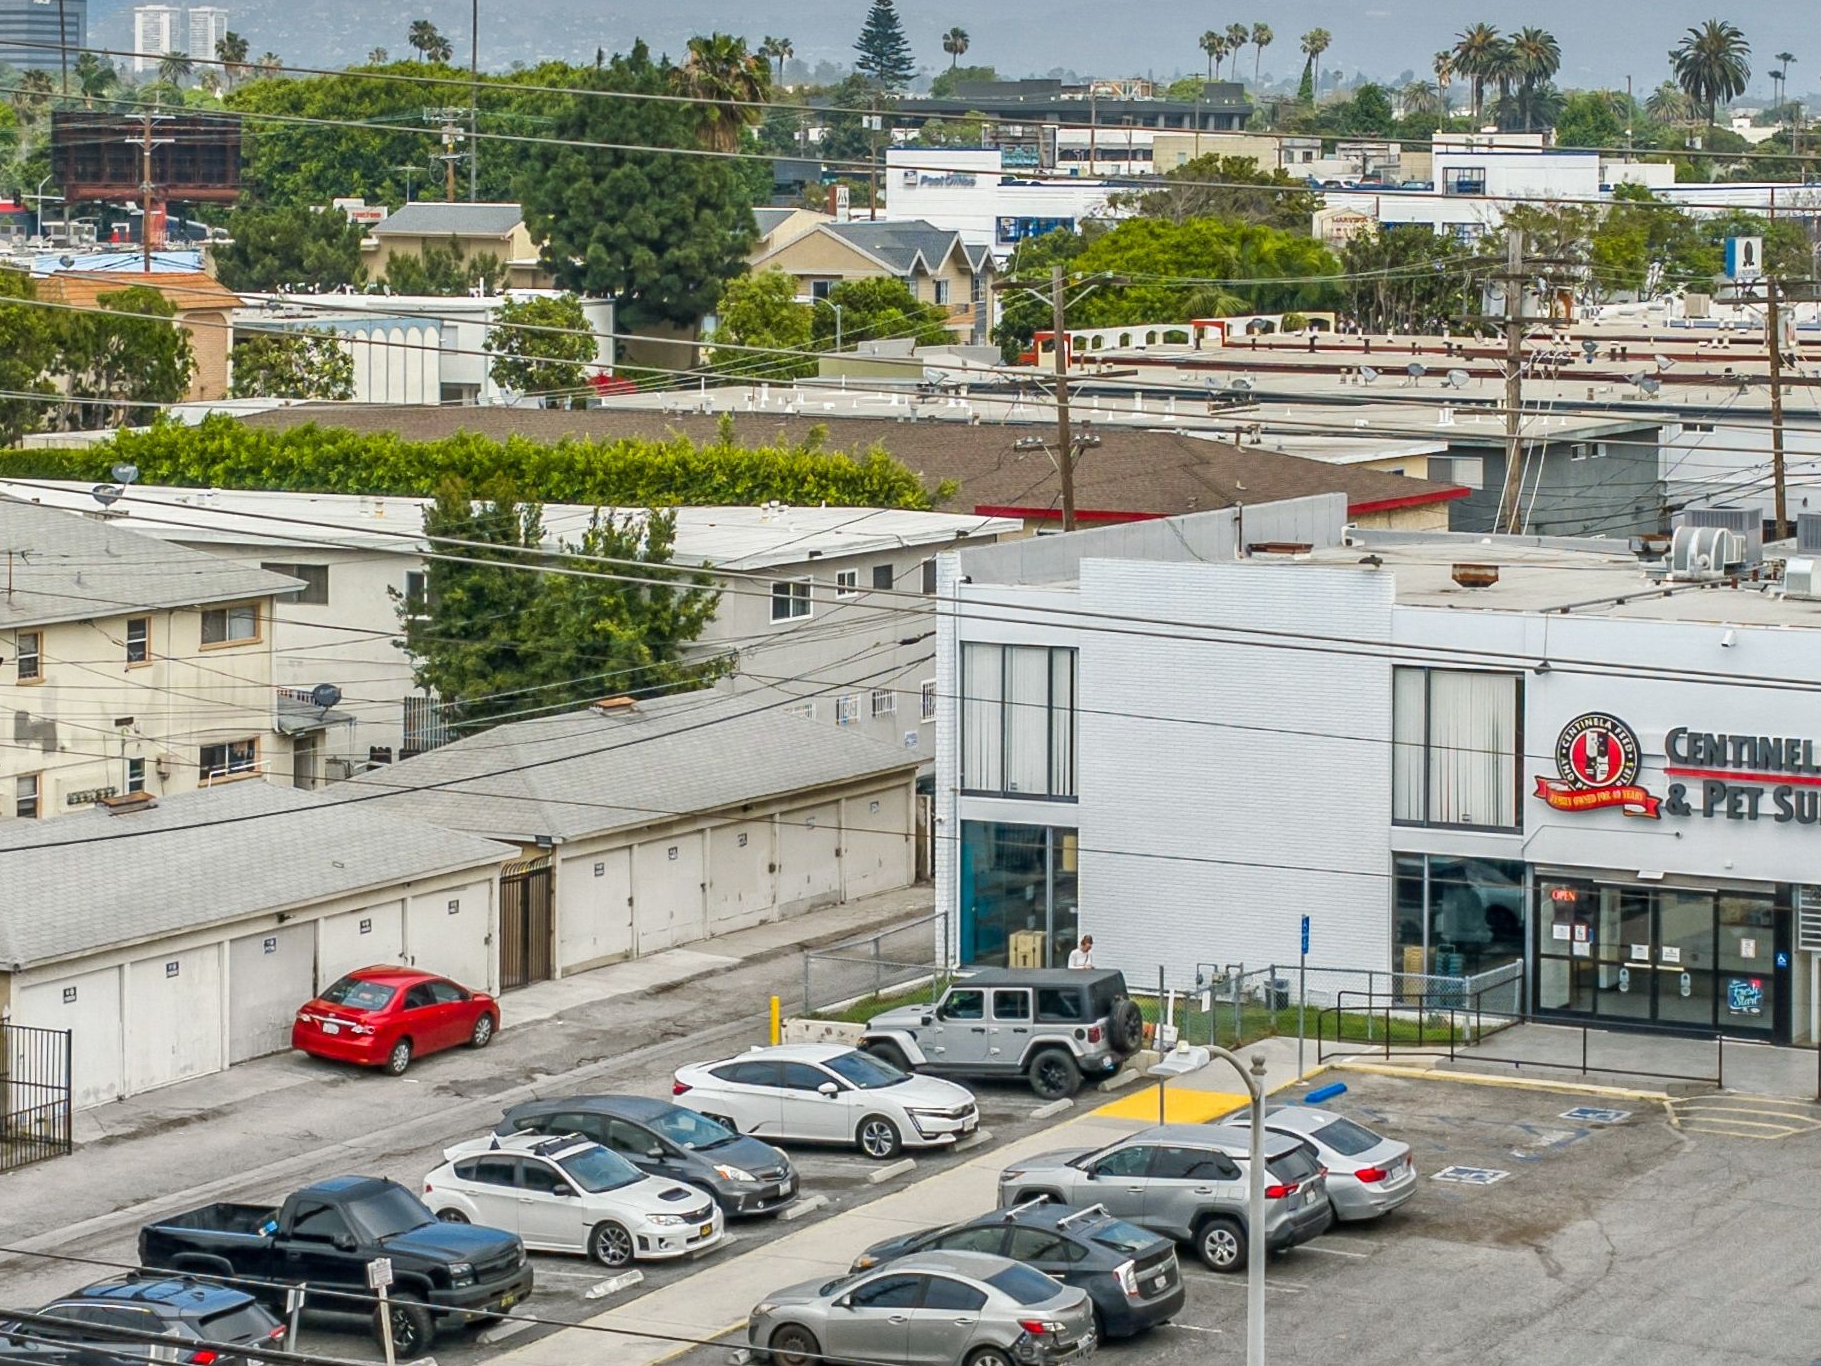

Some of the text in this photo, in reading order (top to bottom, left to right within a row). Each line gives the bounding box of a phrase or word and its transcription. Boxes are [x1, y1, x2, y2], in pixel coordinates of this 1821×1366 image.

[1562, 718, 1633, 752] CENTINELA FEED
[1665, 783, 1691, 816] &
[1703, 780, 1764, 820] PET
[1552, 889, 1576, 901] OPEN
